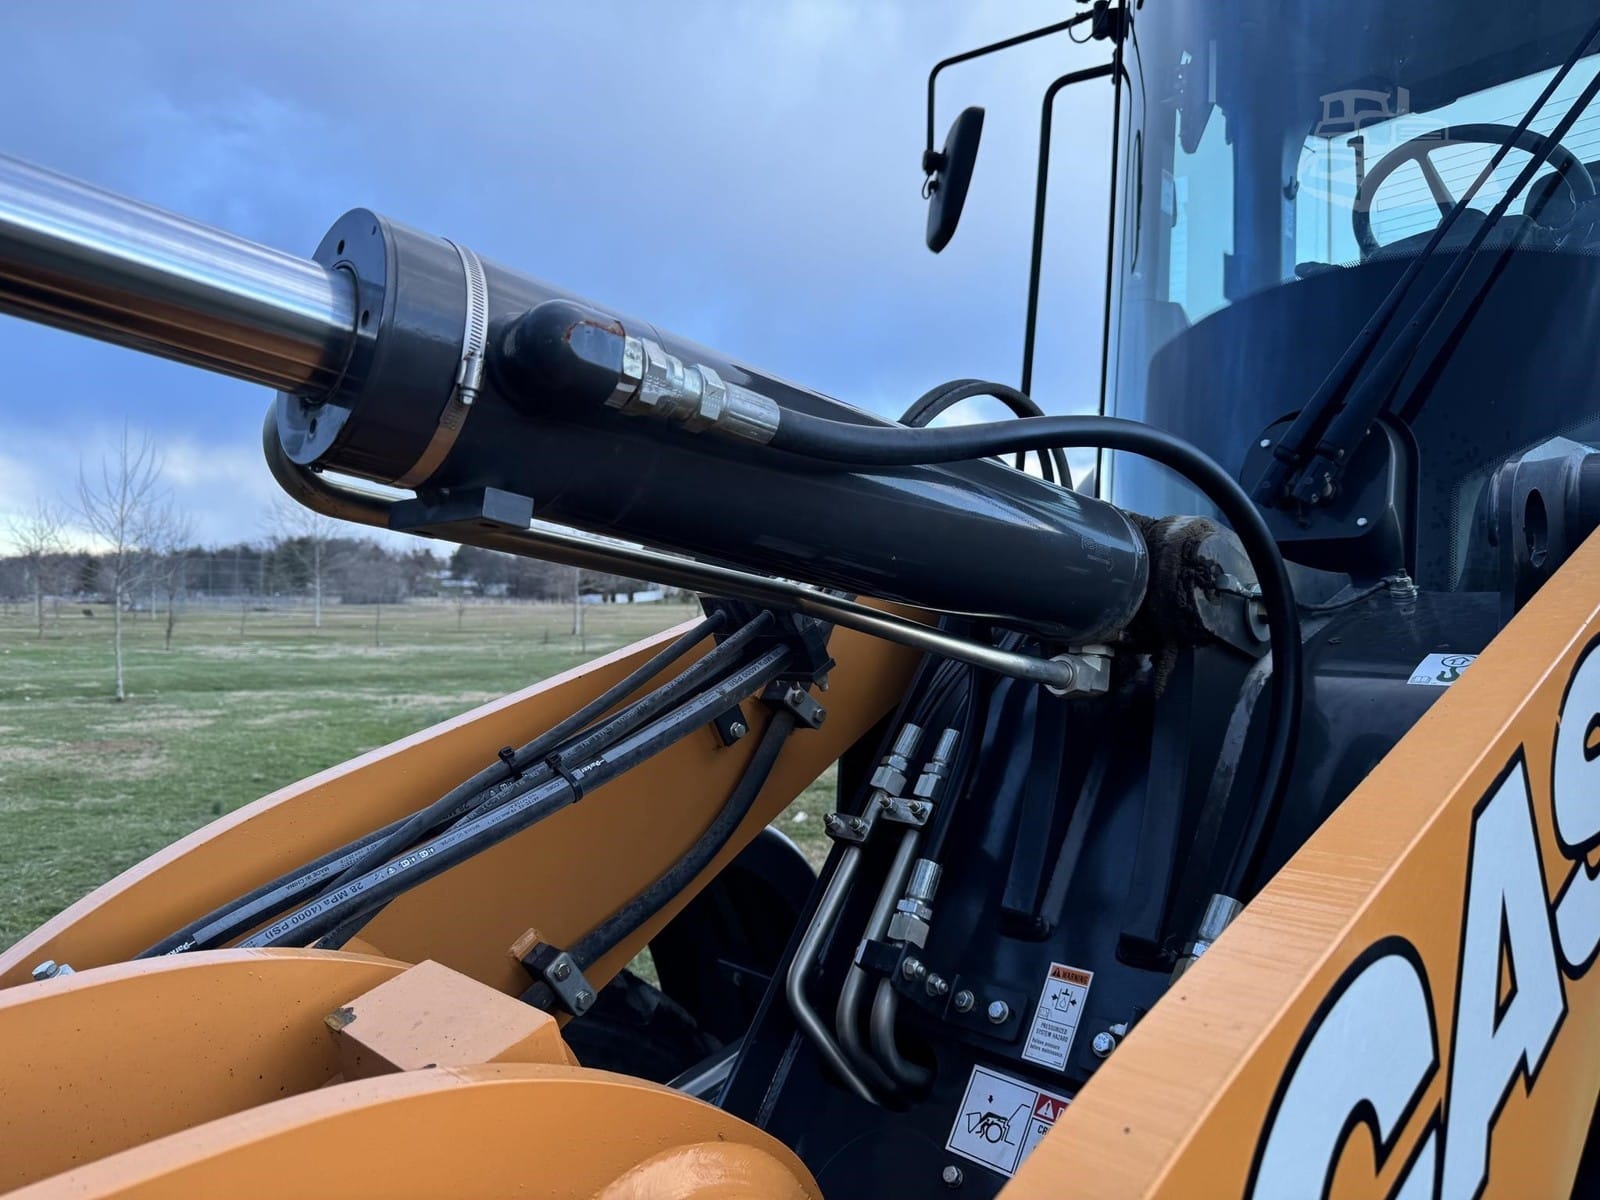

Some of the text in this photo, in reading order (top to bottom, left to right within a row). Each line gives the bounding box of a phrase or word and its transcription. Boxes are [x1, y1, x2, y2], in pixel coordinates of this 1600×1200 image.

[264, 882, 364, 940] 28 MPa (4000 PSI)
[1062, 970, 1089, 986] WARNING
